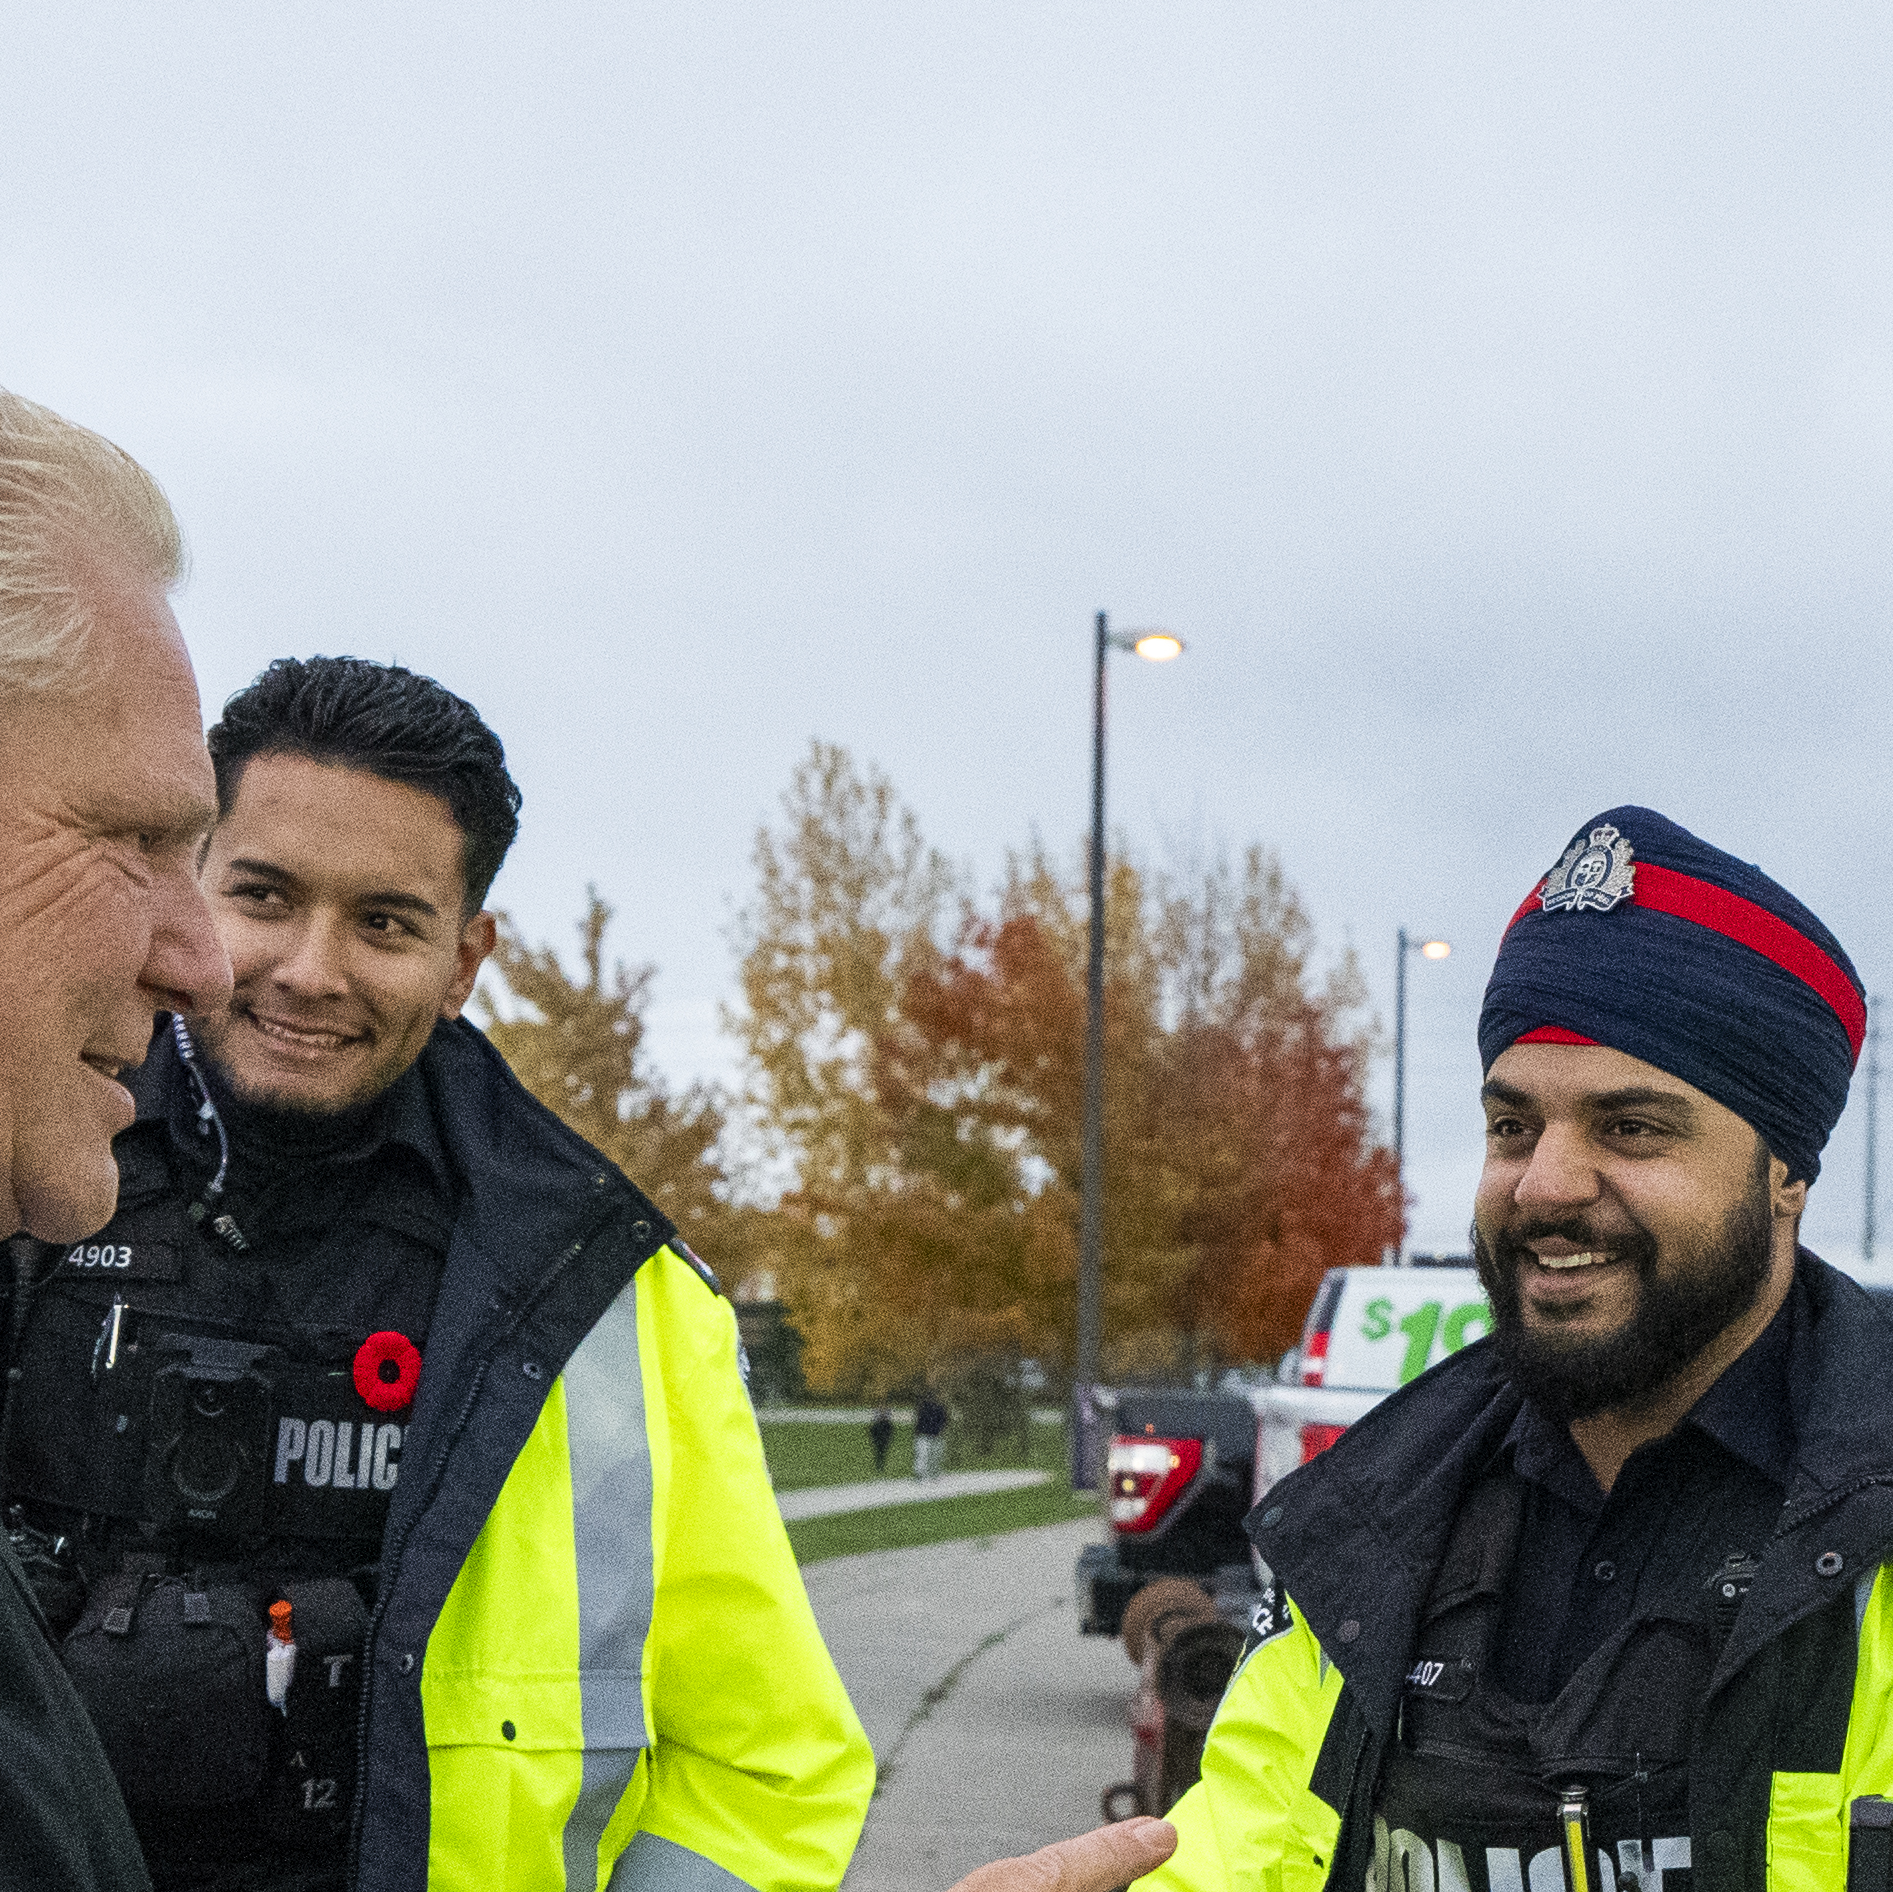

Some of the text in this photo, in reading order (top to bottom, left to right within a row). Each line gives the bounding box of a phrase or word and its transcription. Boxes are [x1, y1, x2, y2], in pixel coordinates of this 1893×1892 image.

[68, 1244, 132, 1268] 4903
[273, 1416, 410, 1491] POLIC
[301, 1778, 337, 1809] 12
